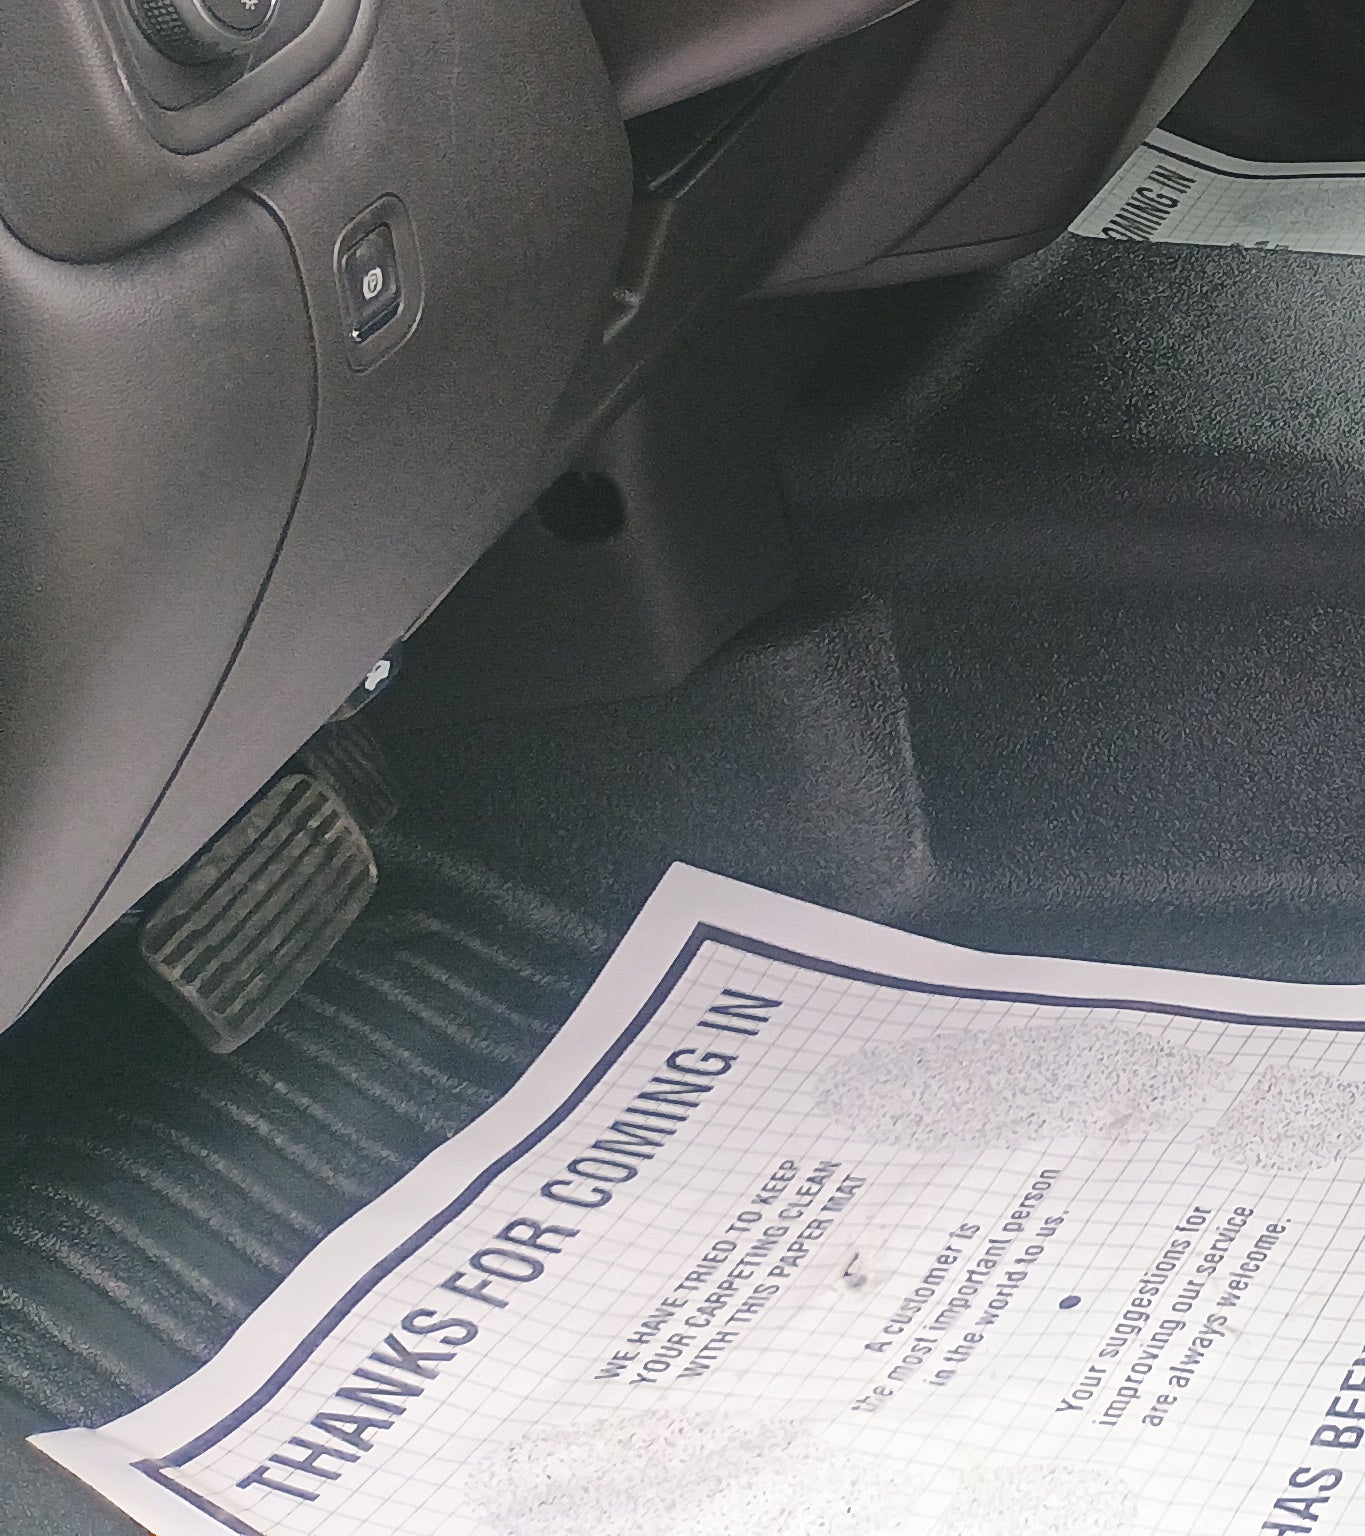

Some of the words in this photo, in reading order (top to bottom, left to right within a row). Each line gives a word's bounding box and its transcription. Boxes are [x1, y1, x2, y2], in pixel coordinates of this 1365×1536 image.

[1147, 165, 1197, 193] IN
[235, 1308, 479, 1502] THANKS
[440, 1217, 580, 1309] FOR
[540, 1047, 738, 1209] COMING
[697, 988, 783, 1036] IN
[594, 1350, 640, 1379] WE
[627, 1297, 688, 1344] HAVE
[673, 1240, 737, 1293] TRIED
[725, 1210, 762, 1234] TO
[751, 1159, 797, 1205] KEEP
[629, 1332, 697, 1385] YOUR
[684, 1225, 789, 1328] CARPETING
[778, 1160, 842, 1221] CLEAN
[676, 1330, 740, 1379] WITH
[724, 1283, 780, 1326] THIS
[767, 1218, 834, 1278] PAPER
[821, 1174, 867, 1213] MAT
[851, 1384, 894, 1412] the
[887, 1336, 938, 1382] most
[922, 1238, 1013, 1331] important
[1002, 1169, 1062, 1233] person
[864, 1340, 893, 1353] A
[883, 1245, 962, 1334] customer
[949, 1222, 981, 1240] is
[922, 1369, 956, 1386] in
[943, 1332, 985, 1363] the
[975, 1270, 1028, 1325] world
[1014, 1244, 1045, 1264] to
[1036, 1210, 1070, 1237] us.
[1055, 1364, 1107, 1412] Your
[1098, 1239, 1191, 1358] suggestions
[1174, 1206, 1212, 1232] for
[1091, 1318, 1186, 1427] improving
[1171, 1279, 1205, 1313] our
[1195, 1206, 1254, 1276] service
[1142, 1394, 1178, 1427] are
[1168, 1313, 1228, 1388] always
[1216, 1218, 1293, 1307] welcome.
